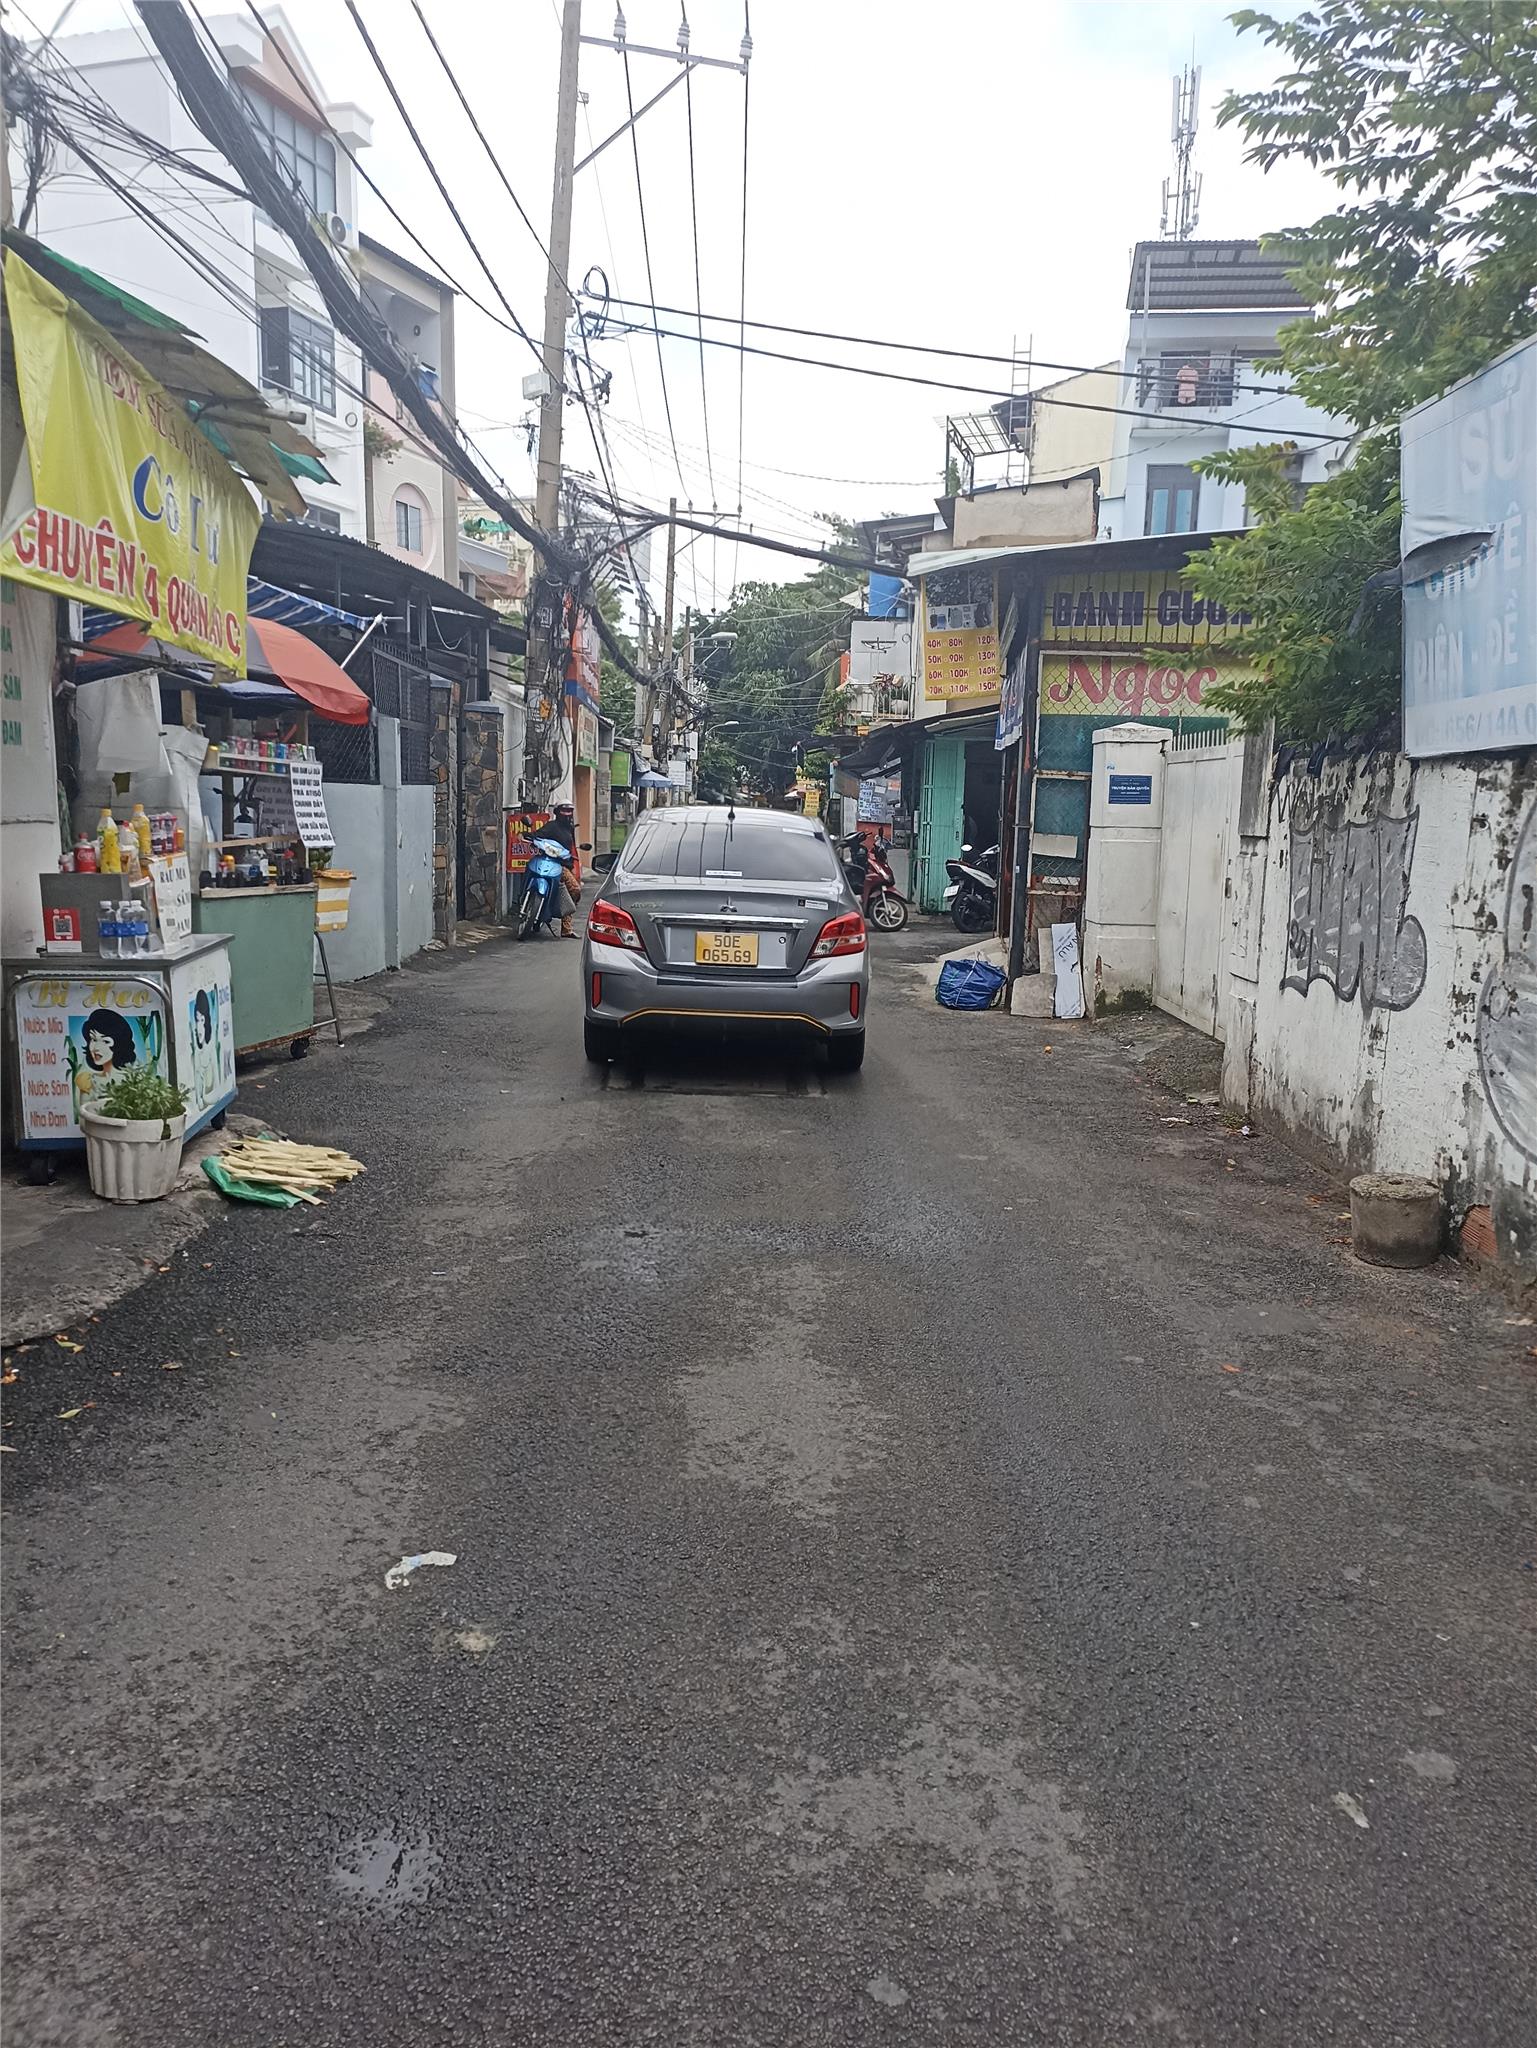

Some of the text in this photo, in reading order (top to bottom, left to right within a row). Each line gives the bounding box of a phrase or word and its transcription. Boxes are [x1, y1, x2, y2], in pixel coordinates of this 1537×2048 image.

[133, 455, 181, 532] Cô
[12, 507, 136, 601] CHUYÊN
[1052, 586, 1145, 627] BÁNH
[927, 635, 996, 648] 40K 80K 120K
[927, 651, 996, 664] 50K 90K 130K
[928, 666, 996, 680] 60K 100K 140K
[929, 682, 997, 695] 70K 110K 150K
[714, 935, 741, 948] 50E
[702, 949, 751, 963] 065.69
[23, 1017, 46, 1034] Nước
[26, 1049, 42, 1065] Rau
[28, 1079, 69, 1096] Nước Sâm
[30, 1111, 47, 1126] Nha
